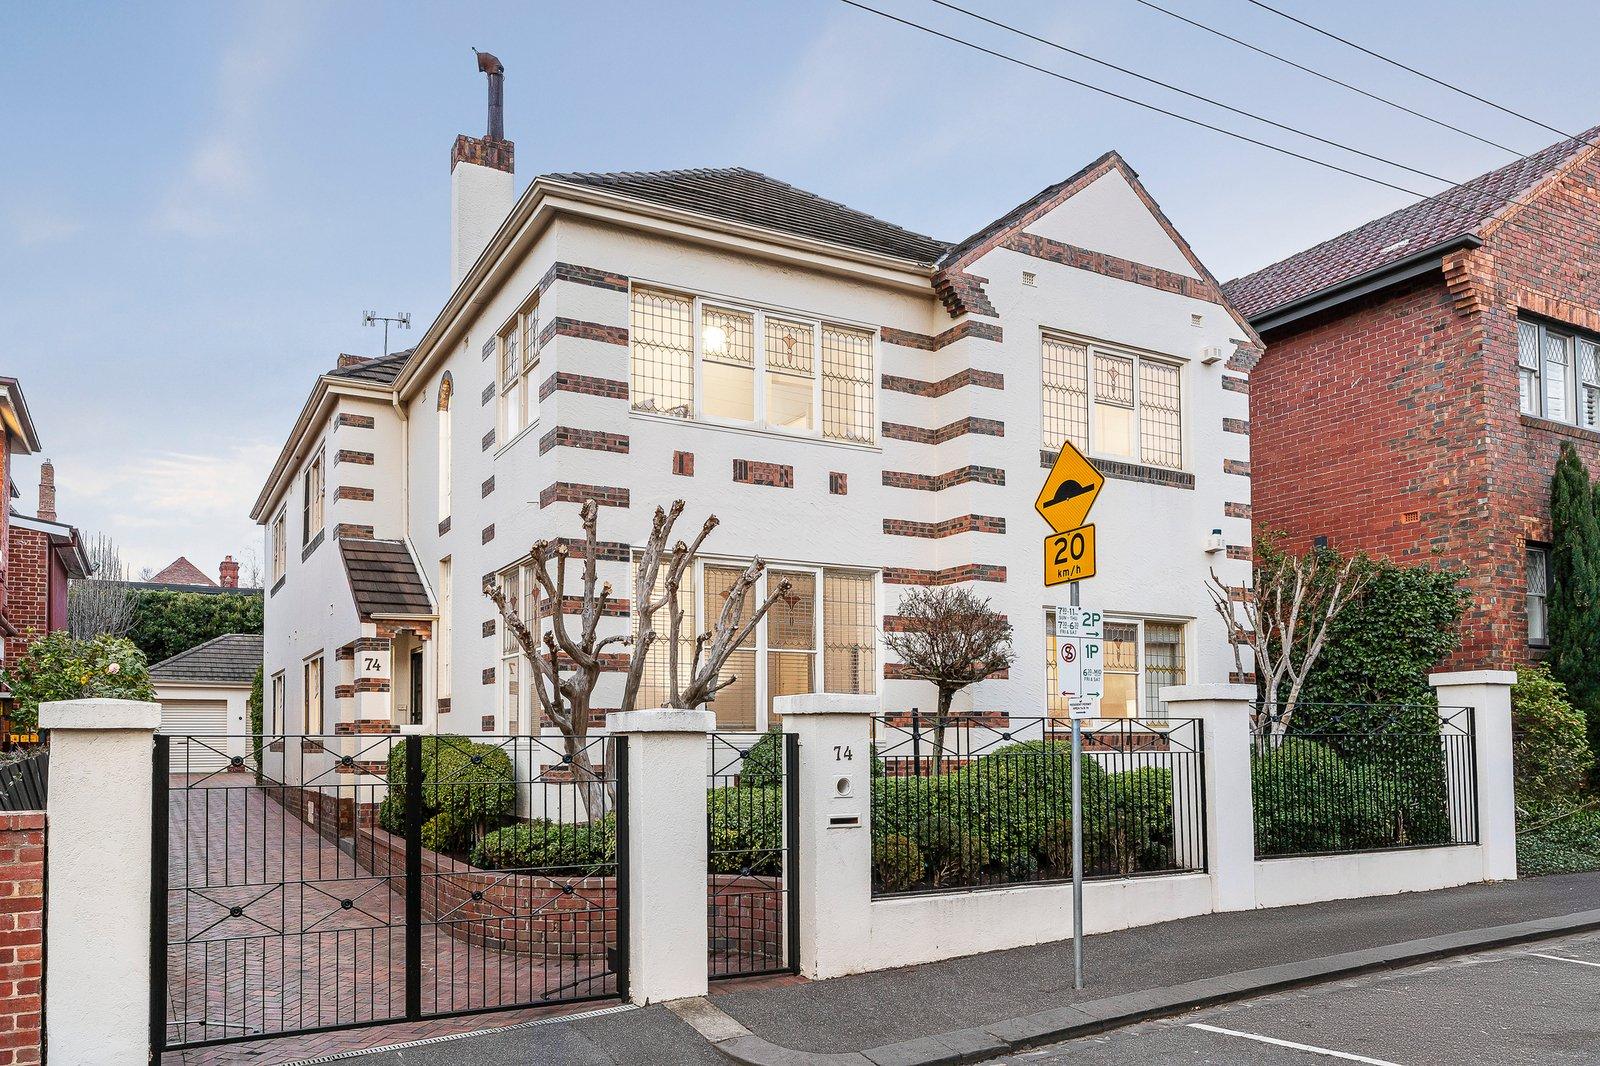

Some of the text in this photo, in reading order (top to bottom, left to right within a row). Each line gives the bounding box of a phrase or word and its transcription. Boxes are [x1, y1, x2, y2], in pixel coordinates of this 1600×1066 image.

[1054, 533, 1085, 565] 20
[1057, 565, 1081, 578] km/h
[1082, 612, 1101, 626] 2P
[1085, 644, 1099, 659] 1P
[364, 658, 382, 671] 74
[833, 745, 853, 761] 74
